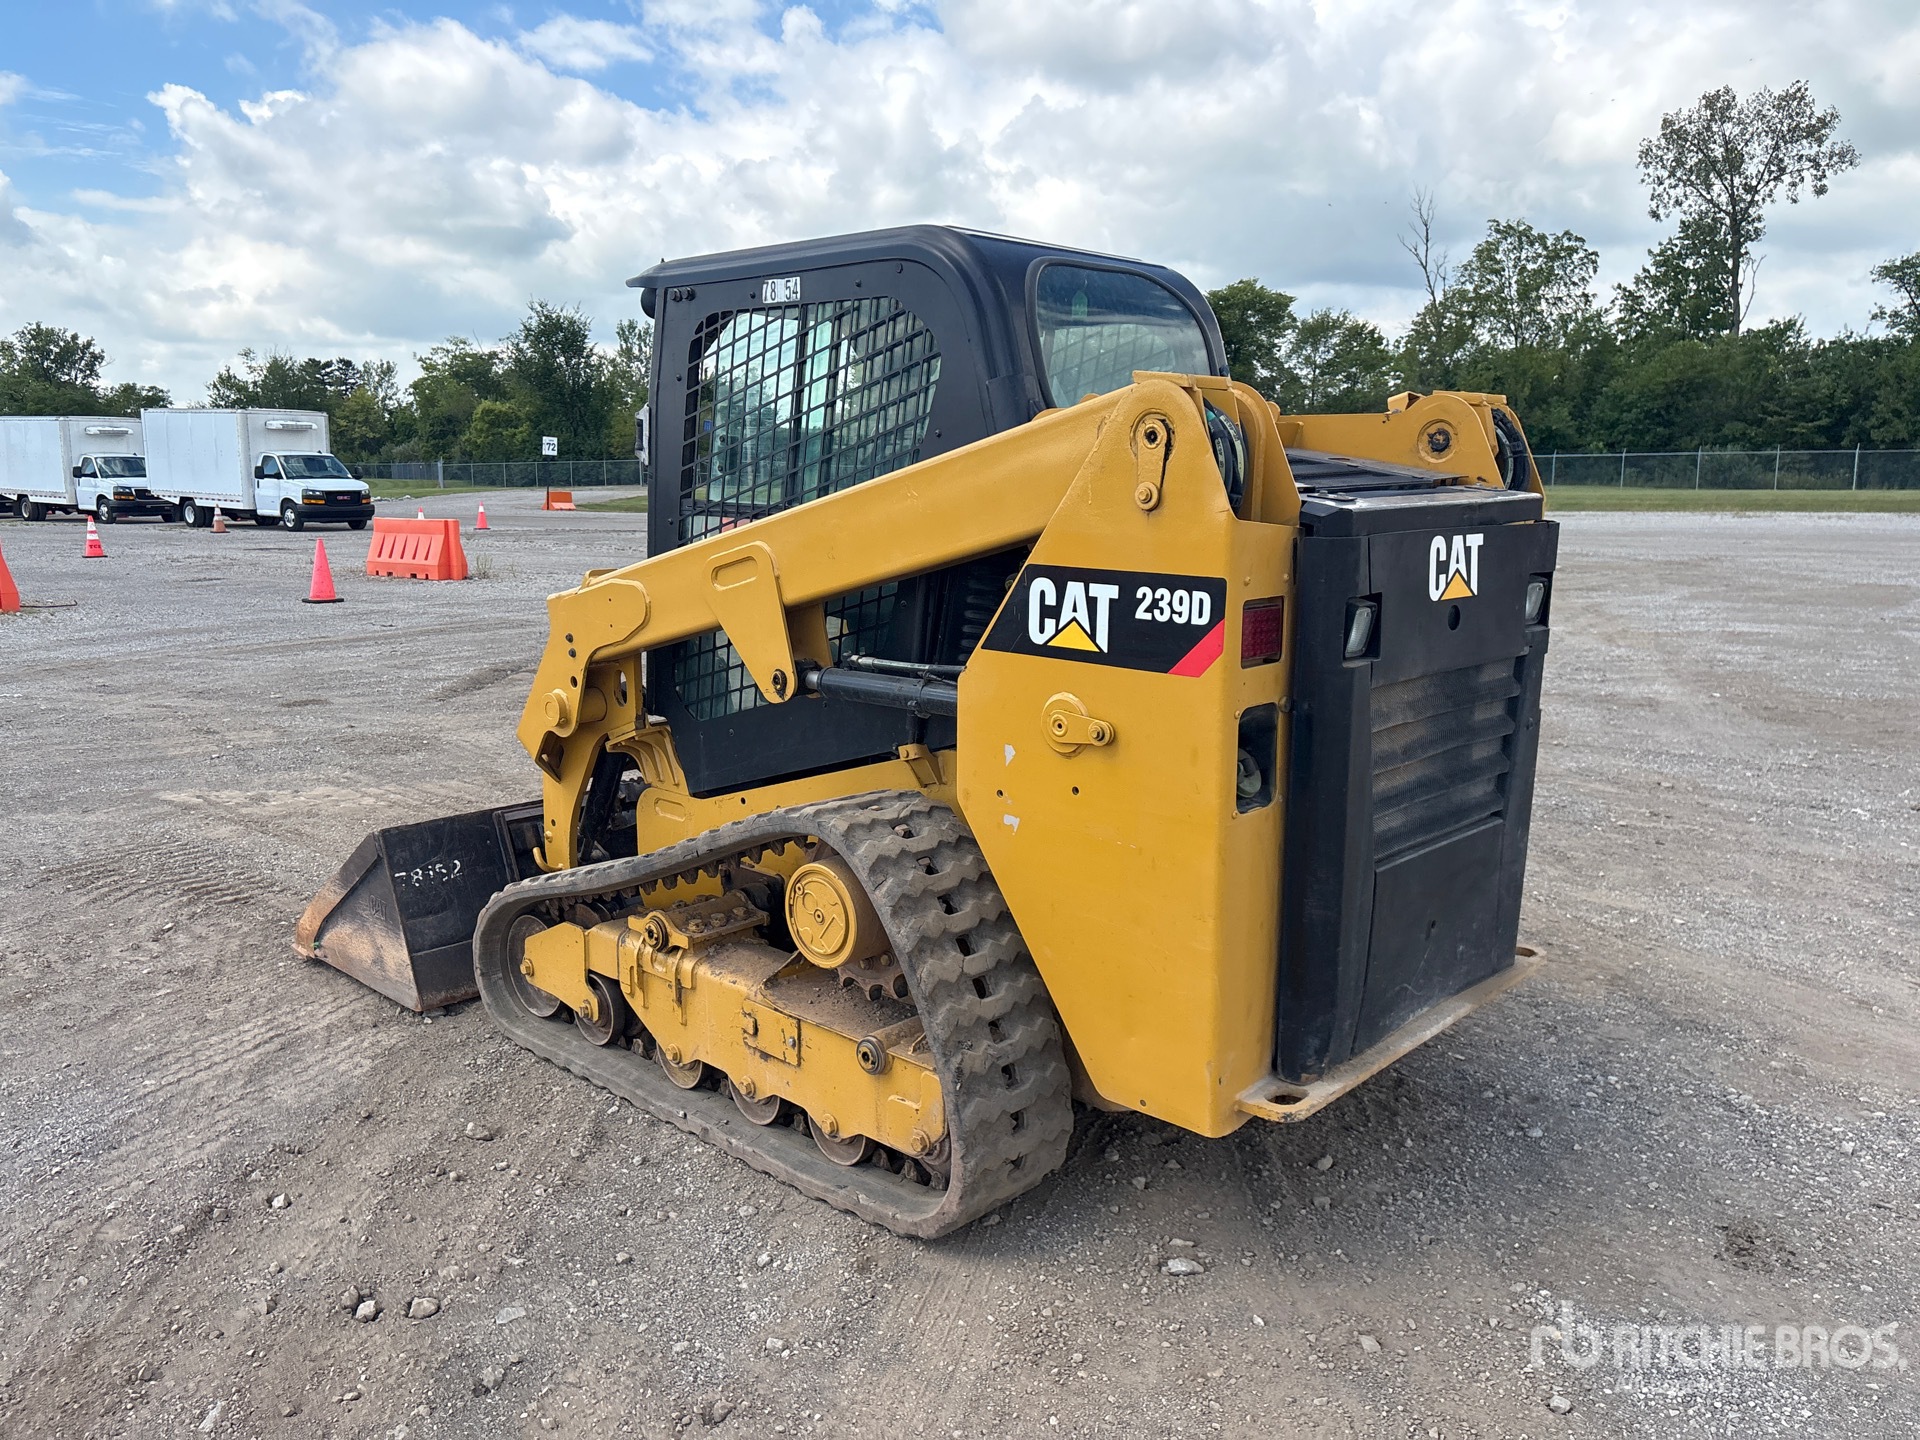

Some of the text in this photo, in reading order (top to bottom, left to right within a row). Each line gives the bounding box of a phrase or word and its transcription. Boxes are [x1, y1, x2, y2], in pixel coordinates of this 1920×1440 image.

[546, 442, 556, 451] 72
[1429, 533, 1484, 601] CAT
[1028, 577, 1211, 653] CAT 239D
